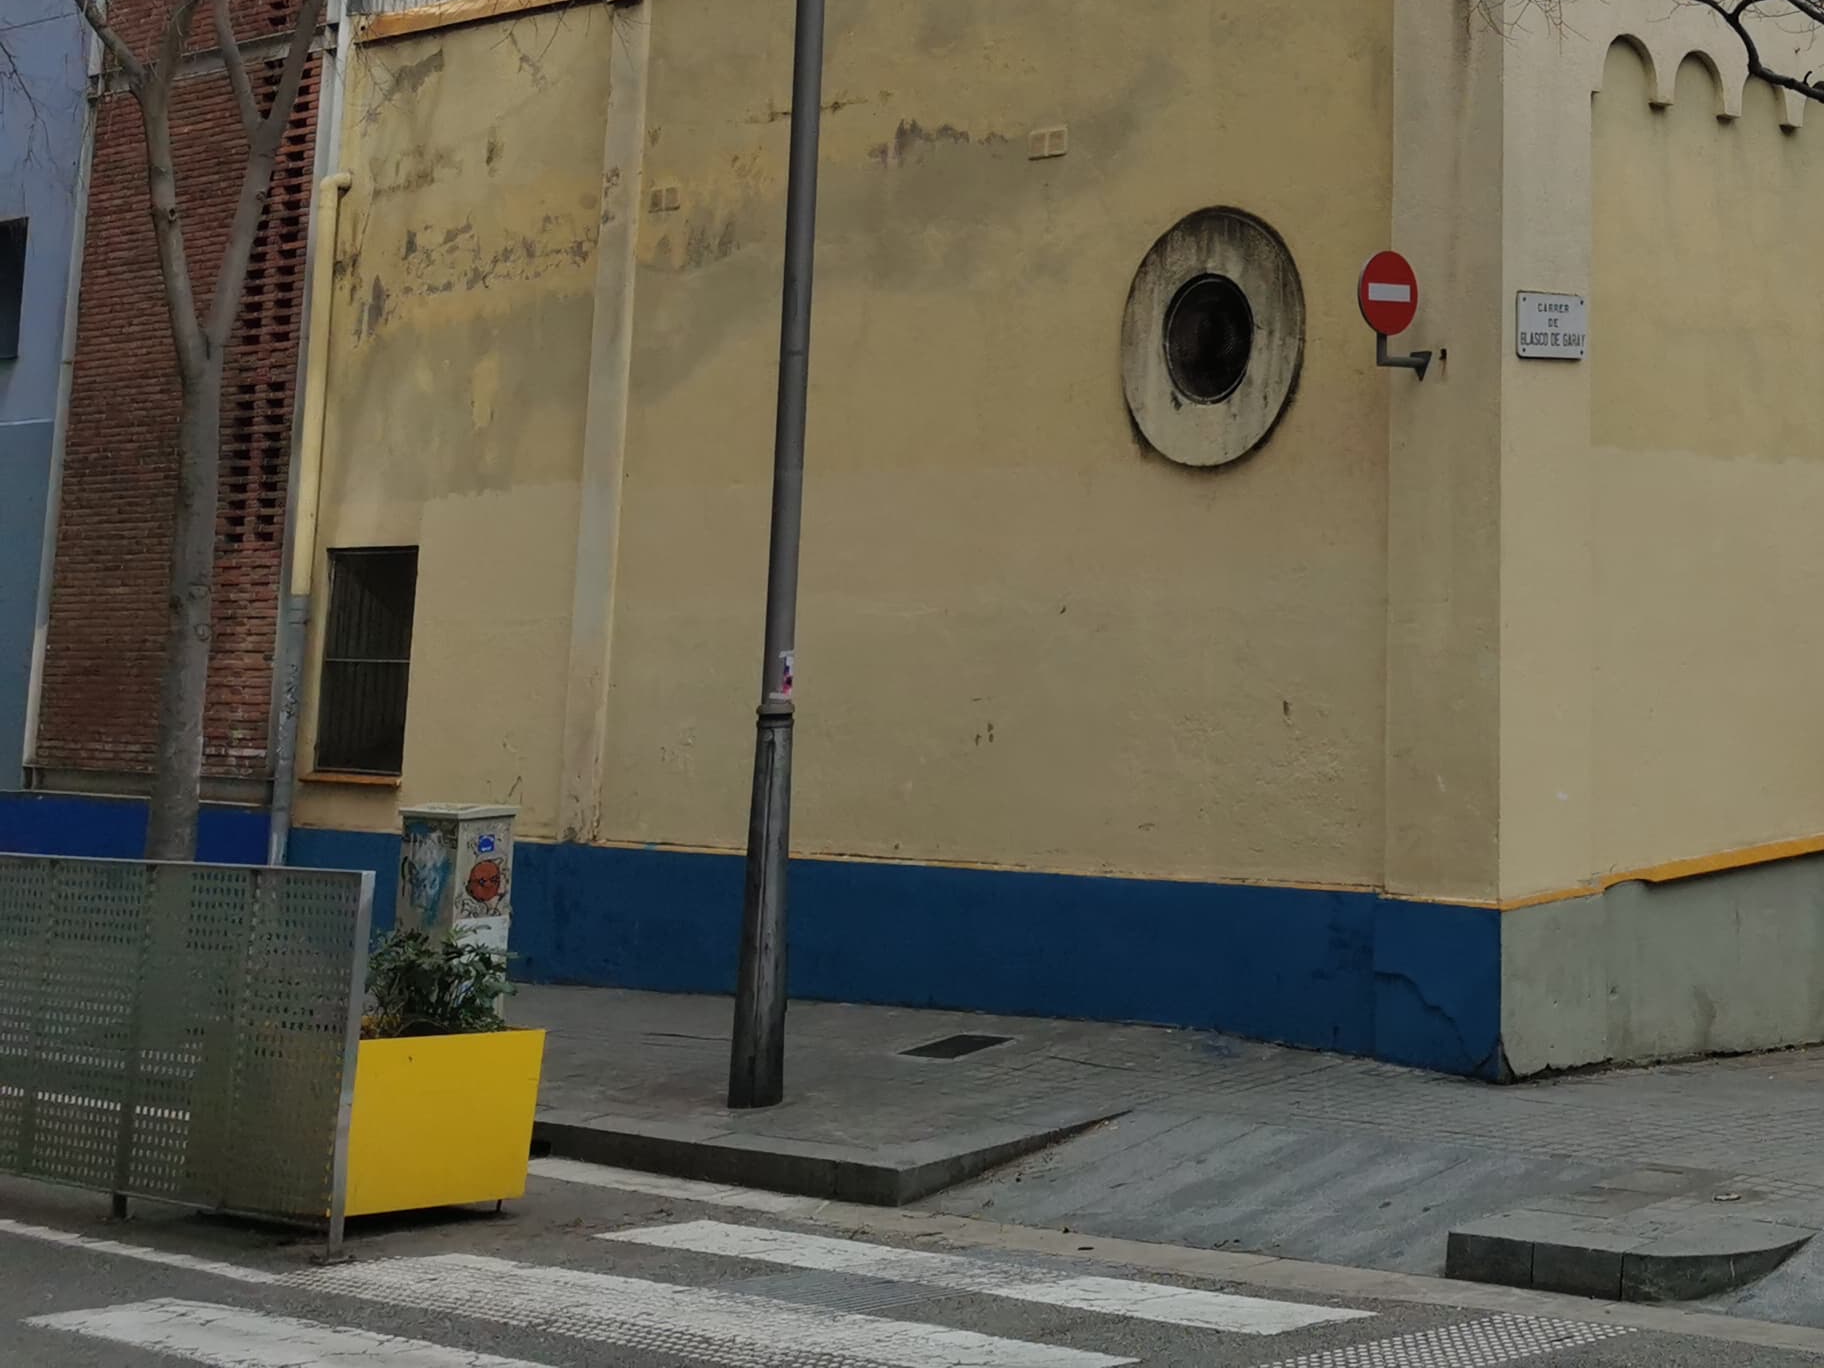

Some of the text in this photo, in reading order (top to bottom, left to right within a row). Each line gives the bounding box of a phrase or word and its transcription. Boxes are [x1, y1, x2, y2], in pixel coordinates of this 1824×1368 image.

[1537, 303, 1570, 313] CARRER
[1547, 318, 1559, 328] DE
[1520, 331, 1586, 347] BLASCO DE GARAY
